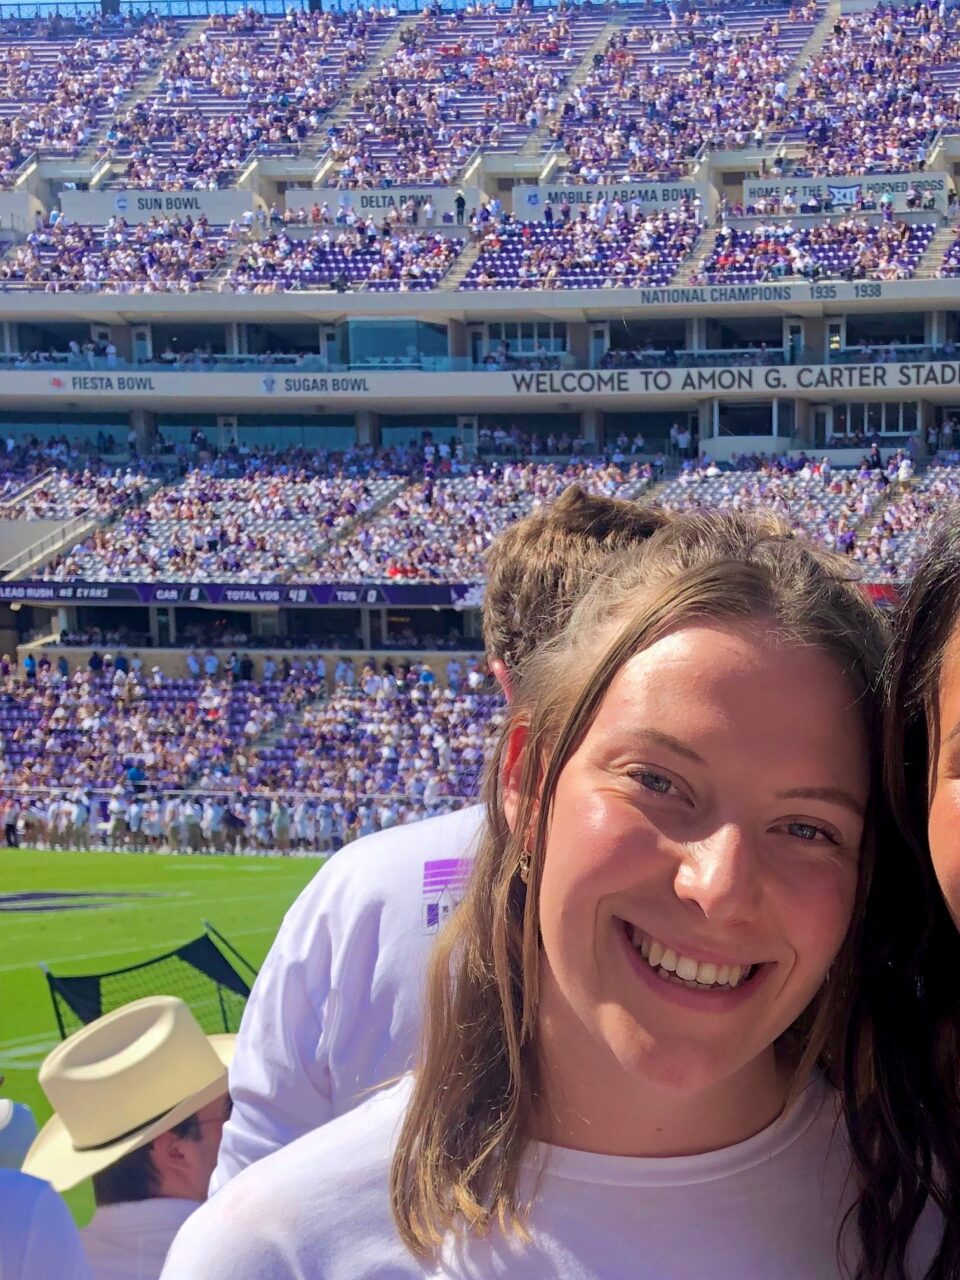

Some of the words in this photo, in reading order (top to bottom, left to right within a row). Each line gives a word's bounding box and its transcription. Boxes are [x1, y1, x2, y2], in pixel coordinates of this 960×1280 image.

[548, 191, 593, 204] MOBILE
[802, 185, 823, 197] THE
[138, 198, 162, 210] SUN
[166, 197, 200, 210] BOWL
[361, 195, 395, 208] DELTA
[641, 288, 706, 304] NATIONAL
[710, 287, 791, 301] CHAMPIONS
[809, 285, 837, 299] 1935
[854, 284, 882, 298] 1938
[72, 377, 113, 391] FIESTA
[118, 377, 155, 391] BOWL
[284, 378, 328, 392] SUGAR
[332, 378, 369, 392] BOWL
[512, 372, 629, 393] WELCOME
[640, 371, 672, 391] TO
[681, 369, 753, 390] AMON
[764, 368, 787, 389] G.
[797, 365, 887, 388] CARTER
[0, 587, 25, 598] LEAD
[26, 587, 54, 598] RUSH
[76, 587, 108, 598] EVANS
[156, 589, 178, 600] CAR
[225, 590, 257, 601] TOTAL
[258, 590, 280, 601] YDS
[336, 590, 357, 601] TDS
[367, 589, 377, 602] 0
